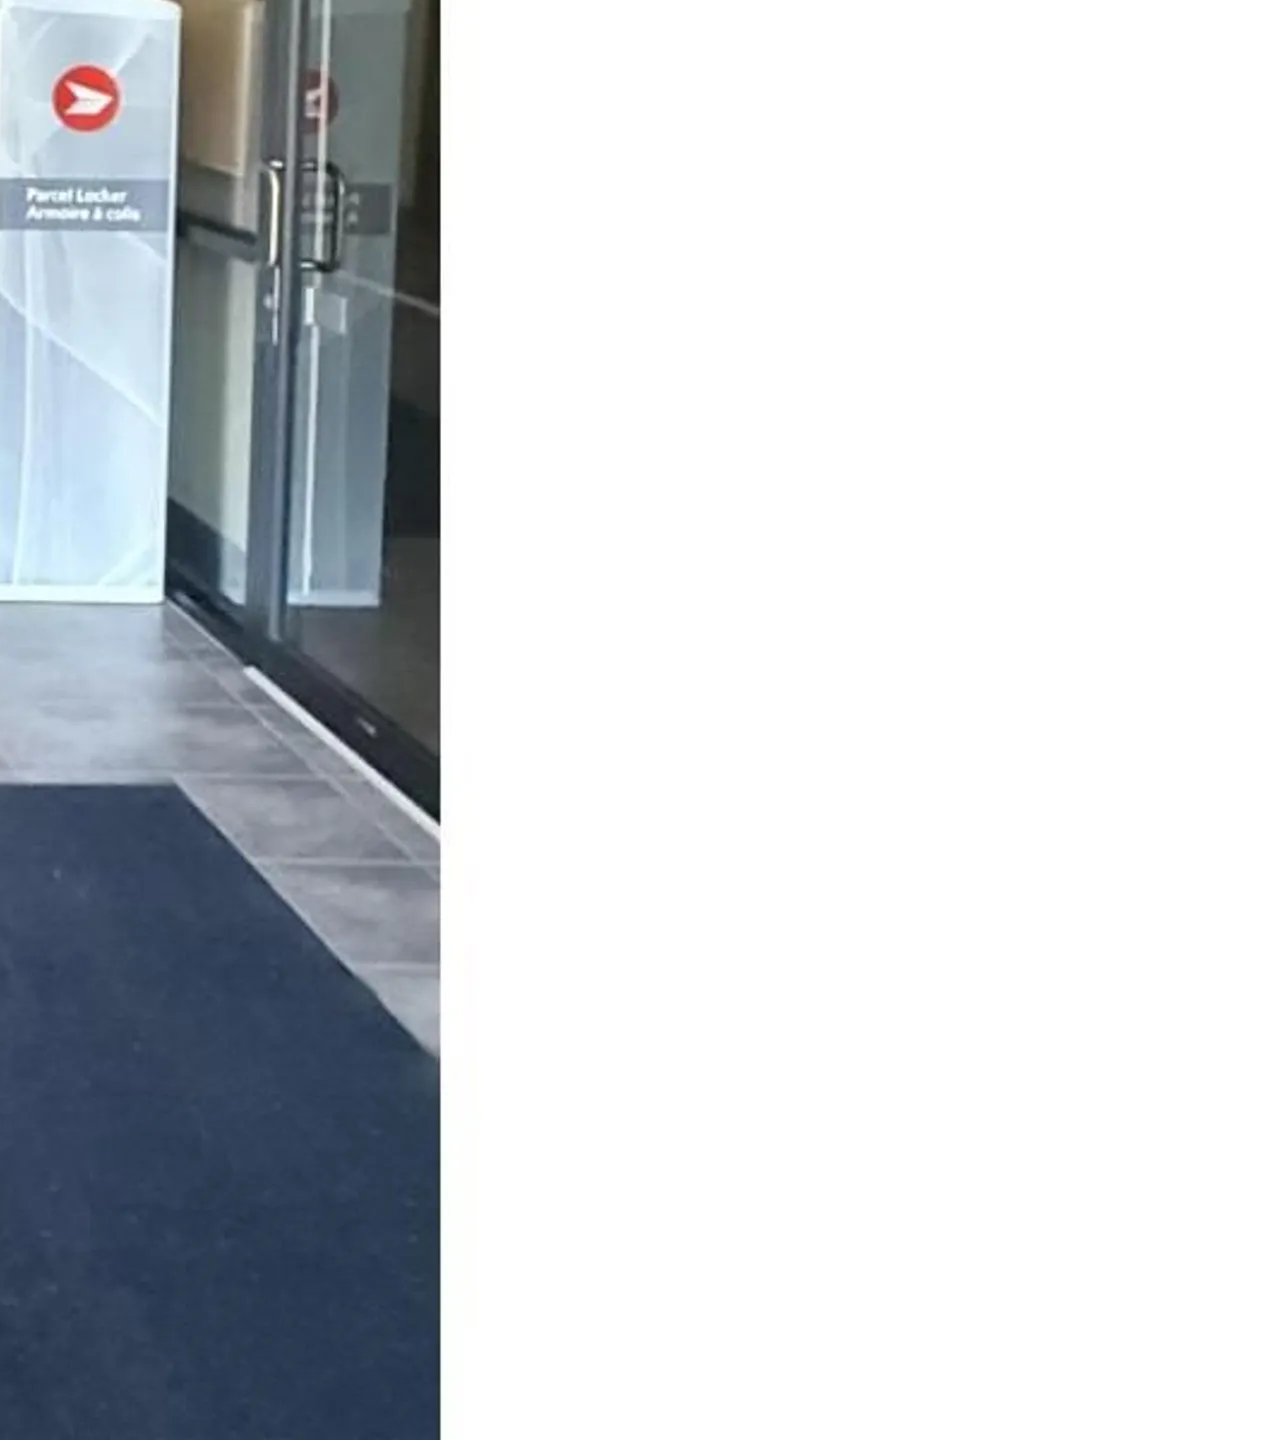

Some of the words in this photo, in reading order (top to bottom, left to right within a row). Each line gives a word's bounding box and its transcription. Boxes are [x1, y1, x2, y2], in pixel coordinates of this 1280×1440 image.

[26, 186, 73, 203] Parcel
[77, 186, 128, 204] Locker
[25, 204, 90, 221] Armoire
